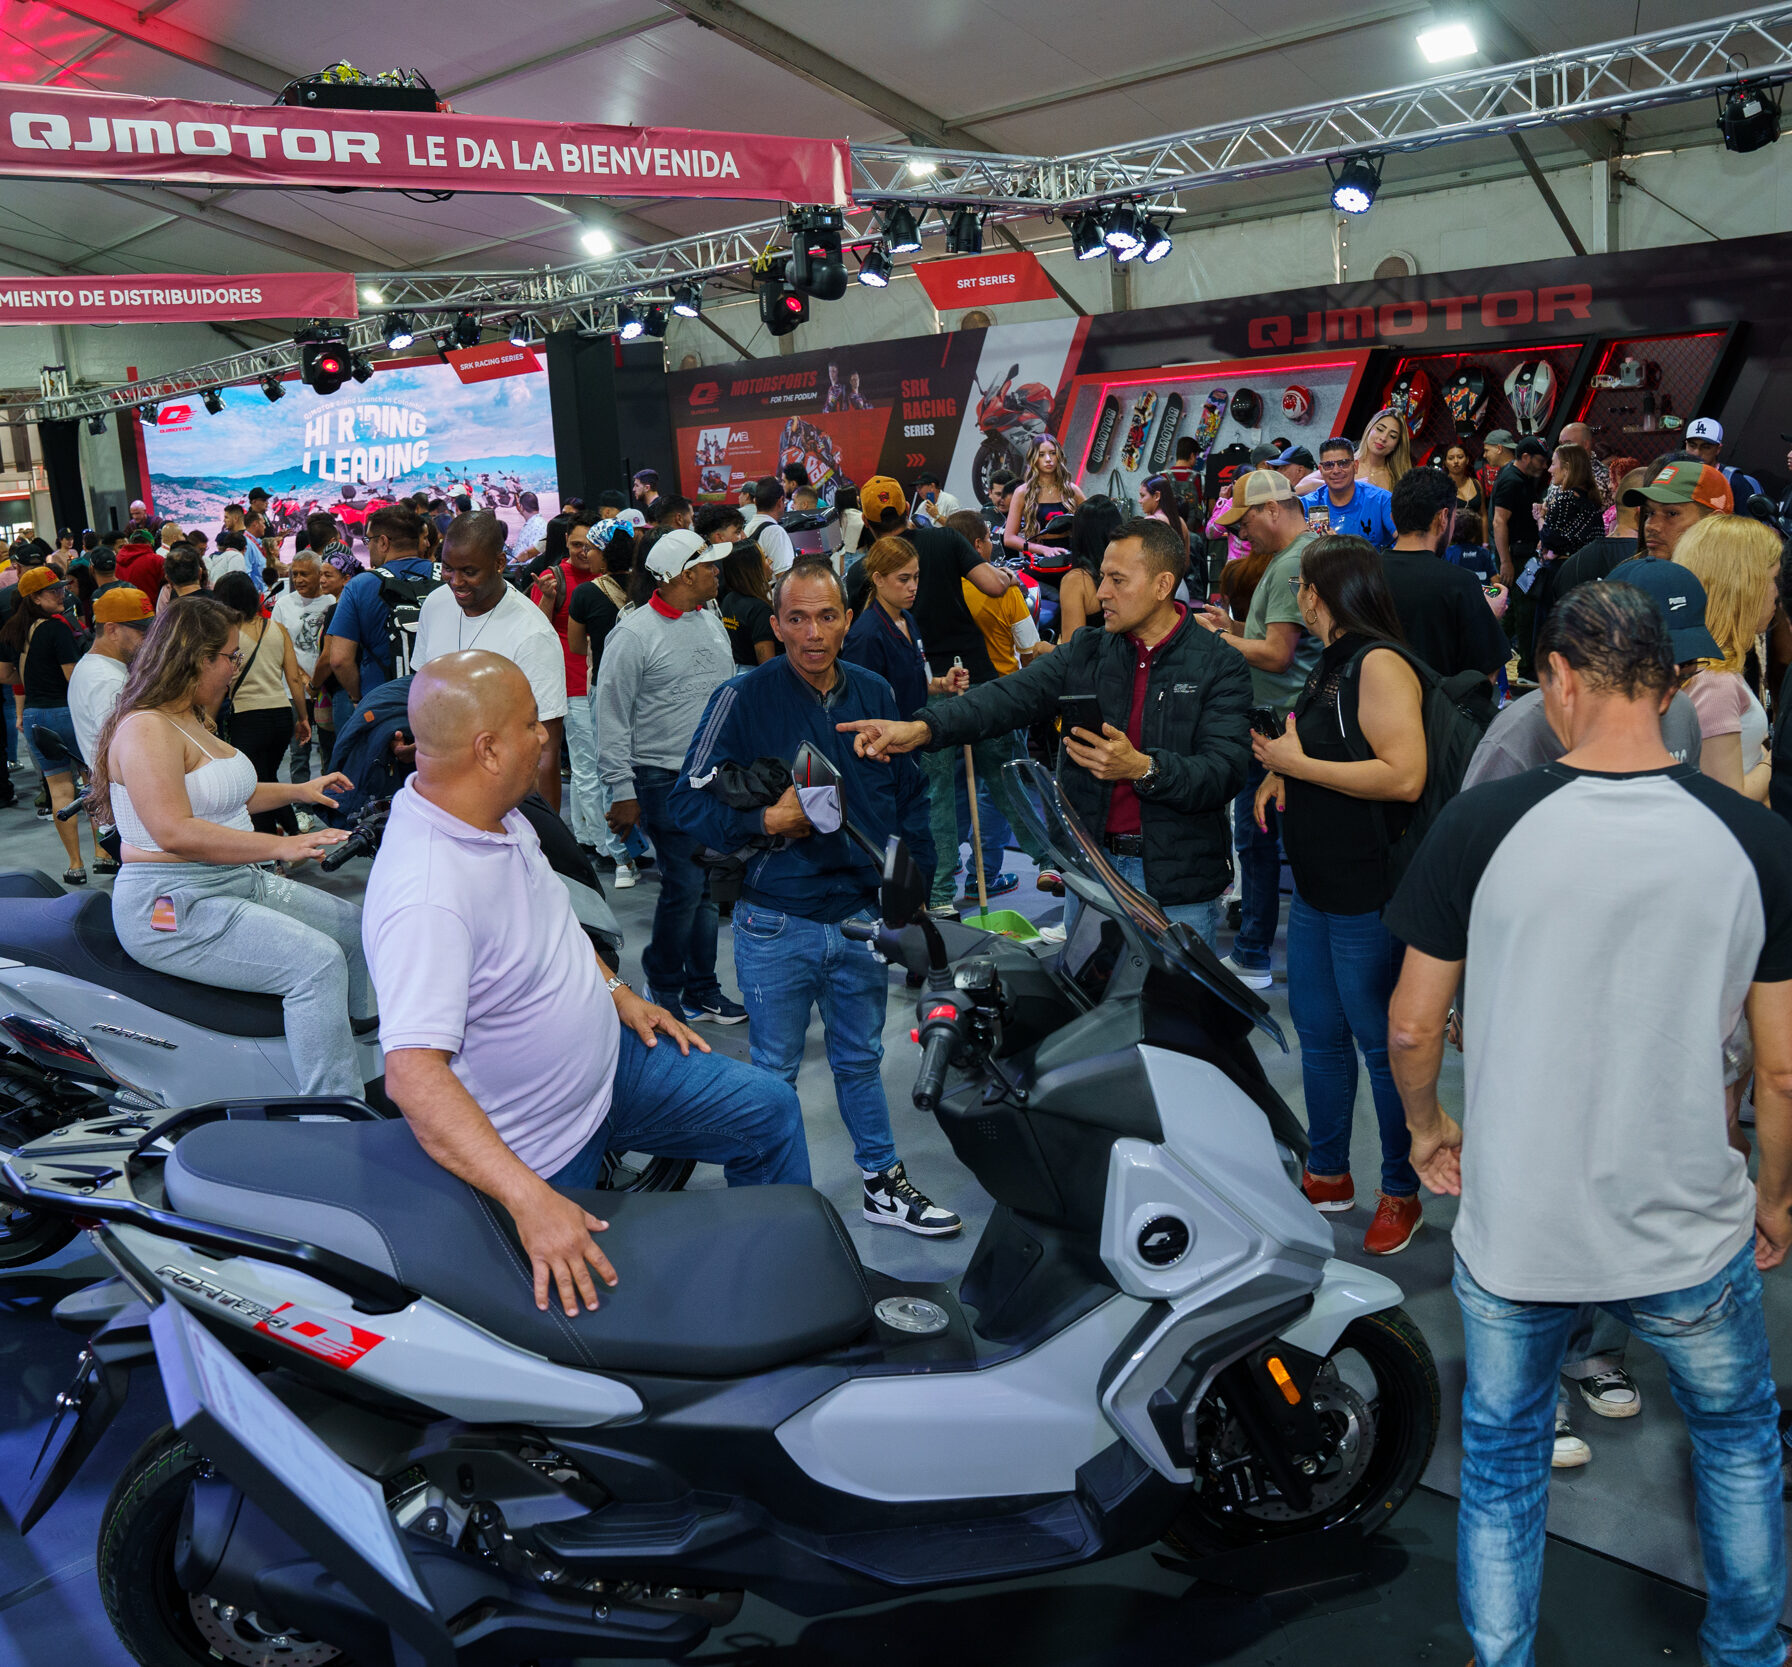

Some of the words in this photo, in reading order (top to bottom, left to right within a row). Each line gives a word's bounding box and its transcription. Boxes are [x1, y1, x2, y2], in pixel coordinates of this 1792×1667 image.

[10, 112, 381, 164] QJMOTOR
[406, 134, 448, 167] LE
[457, 138, 505, 169] DA
[512, 140, 555, 172] LA
[560, 143, 741, 179] BIENVENIDA
[956, 277, 977, 289] SRT
[979, 273, 1016, 287] SERIES
[80, 289, 106, 306] DE
[110, 287, 262, 305] DISTRIBUIDORES
[1248, 283, 1593, 350] QJMOTOR
[460, 363, 474, 371] SRK
[475, 357, 500, 368] RACING
[501, 353, 524, 363] SERIES
[730, 370, 818, 397] MOTORSPORTS
[901, 378, 930, 398] SRK
[770, 395, 782, 404] FOR
[783, 394, 794, 402] THE
[794, 391, 818, 401] PODIUM
[903, 397, 957, 420] RACING
[304, 412, 331, 448] HI
[904, 423, 935, 438] SERIES
[318, 440, 430, 483] LEADING
